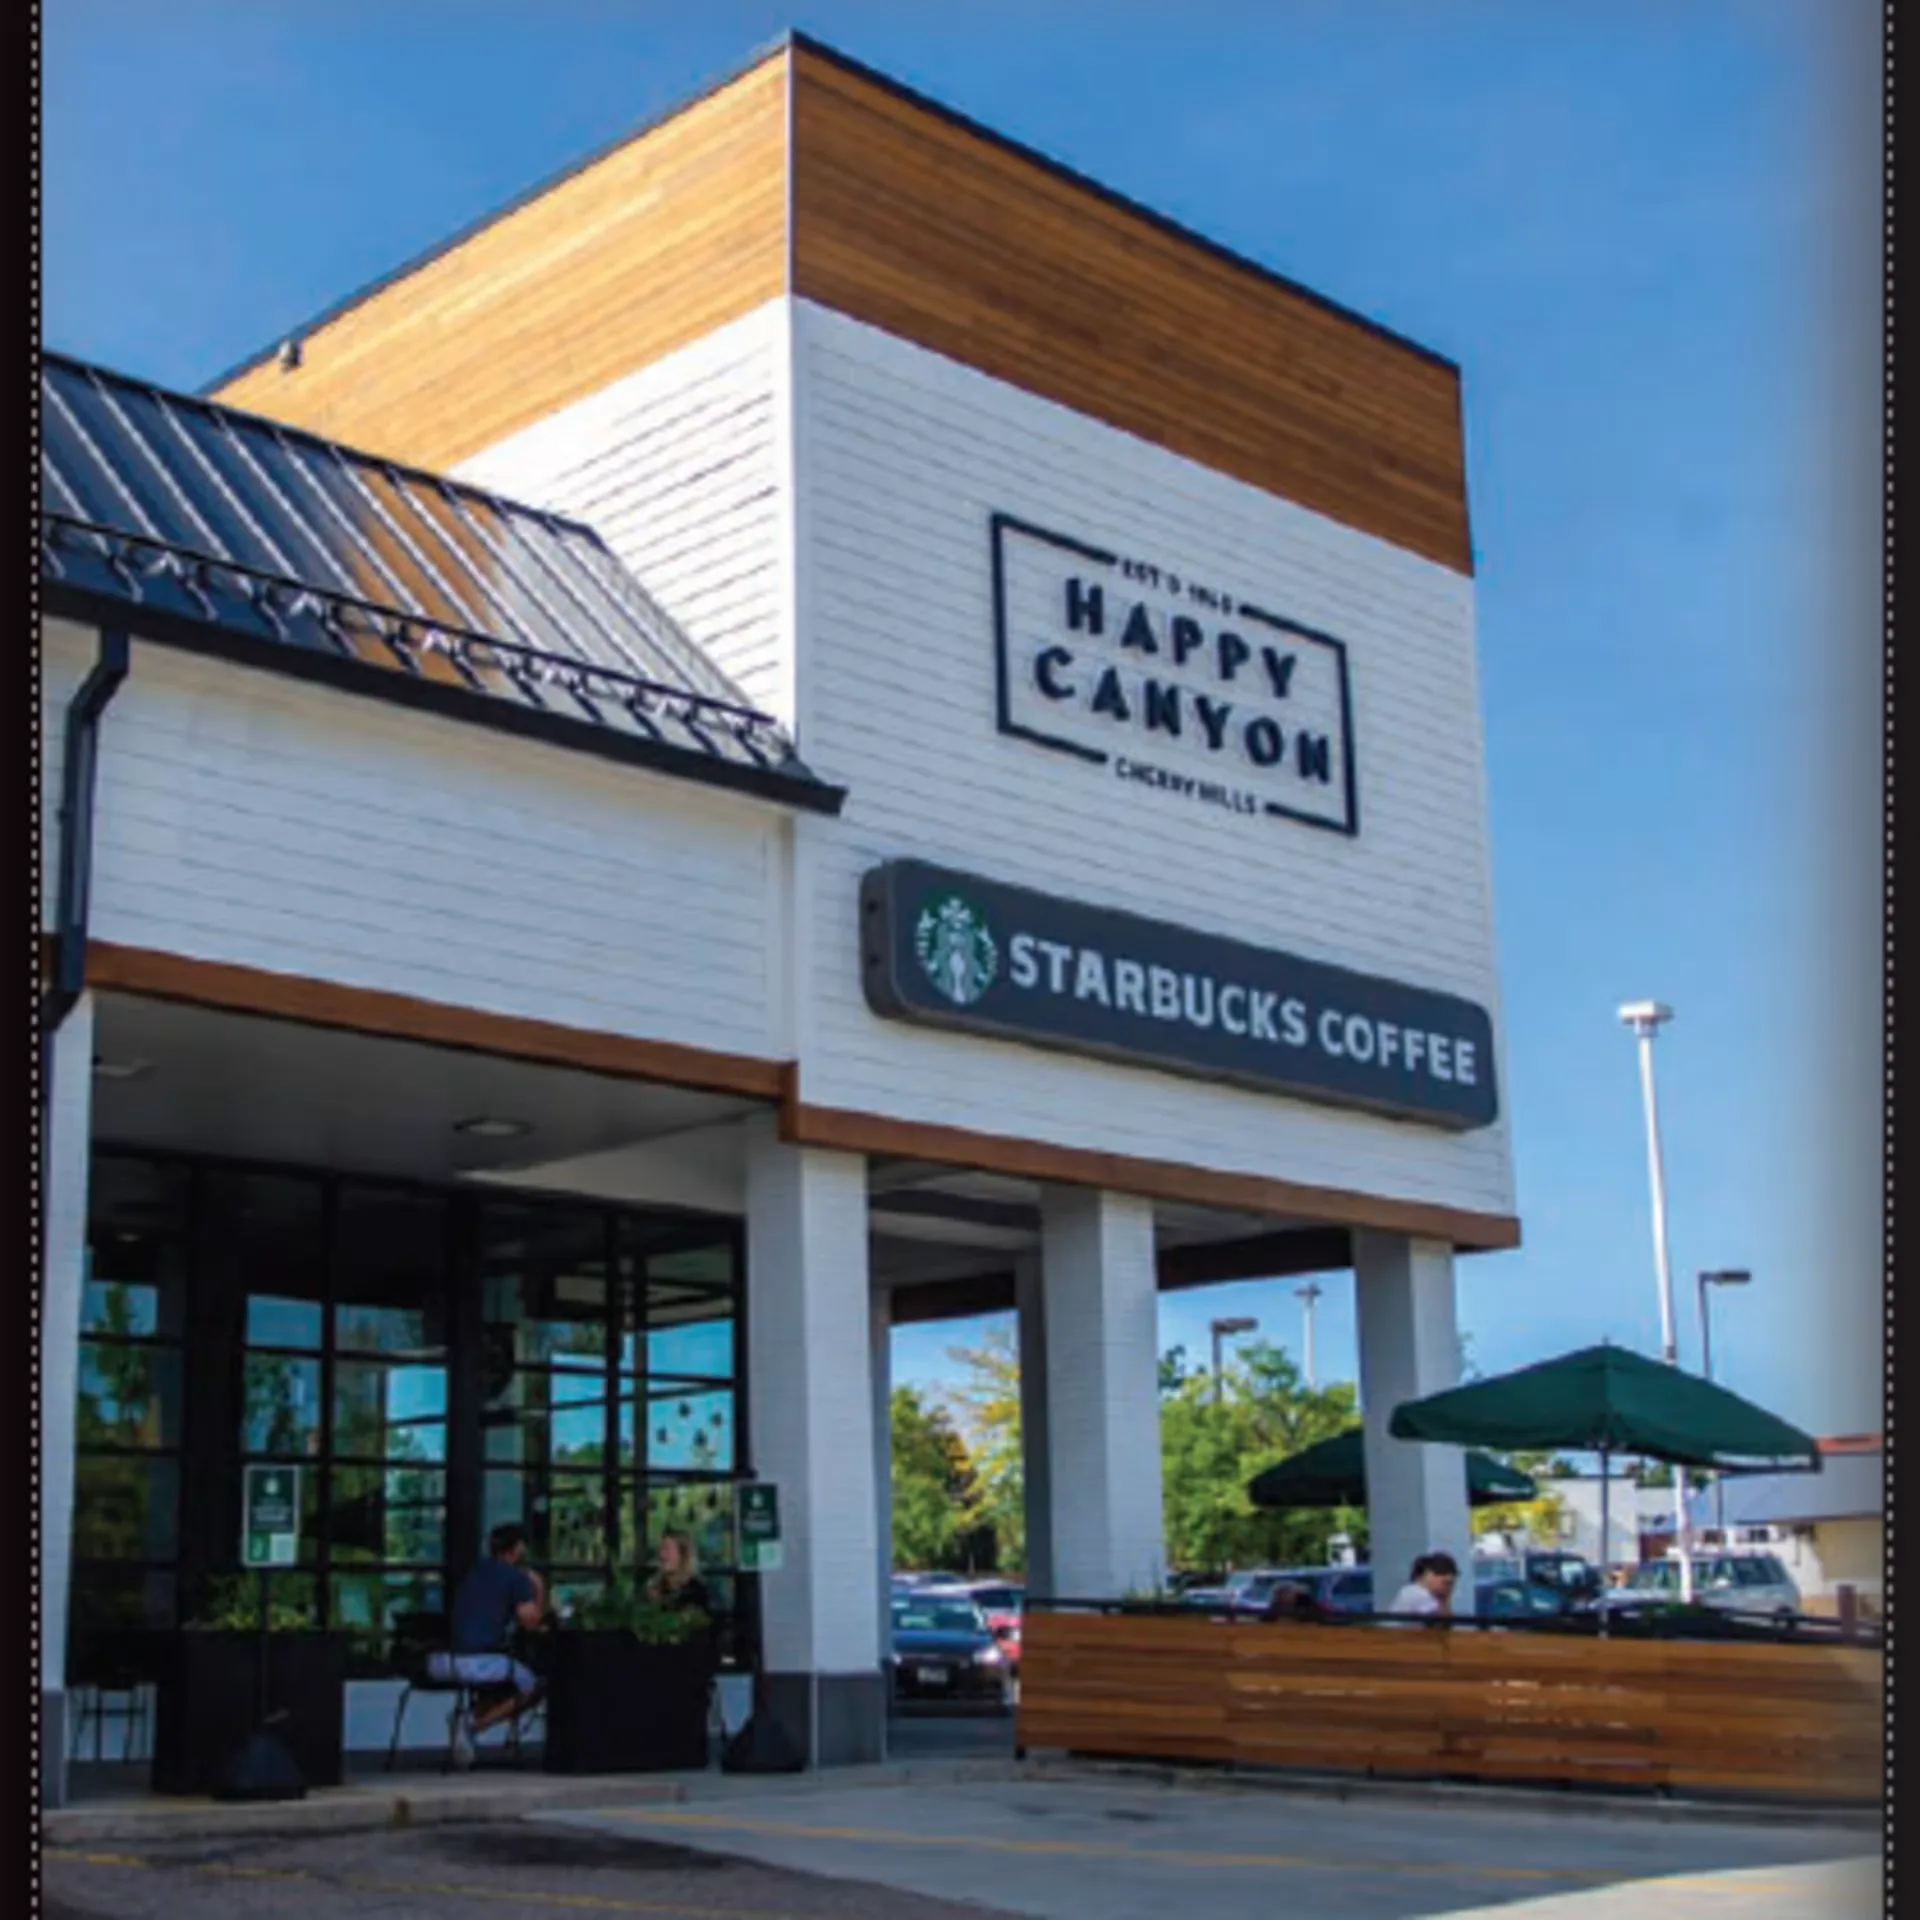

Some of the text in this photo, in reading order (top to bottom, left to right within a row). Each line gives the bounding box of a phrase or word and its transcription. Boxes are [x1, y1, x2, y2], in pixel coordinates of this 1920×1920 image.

[1065, 577, 1296, 699] HAPPY
[1034, 645, 1331, 785] CANYON
[1009, 933, 1308, 1047] STARBUCKS
[1318, 1008, 1477, 1086] COFFEE
